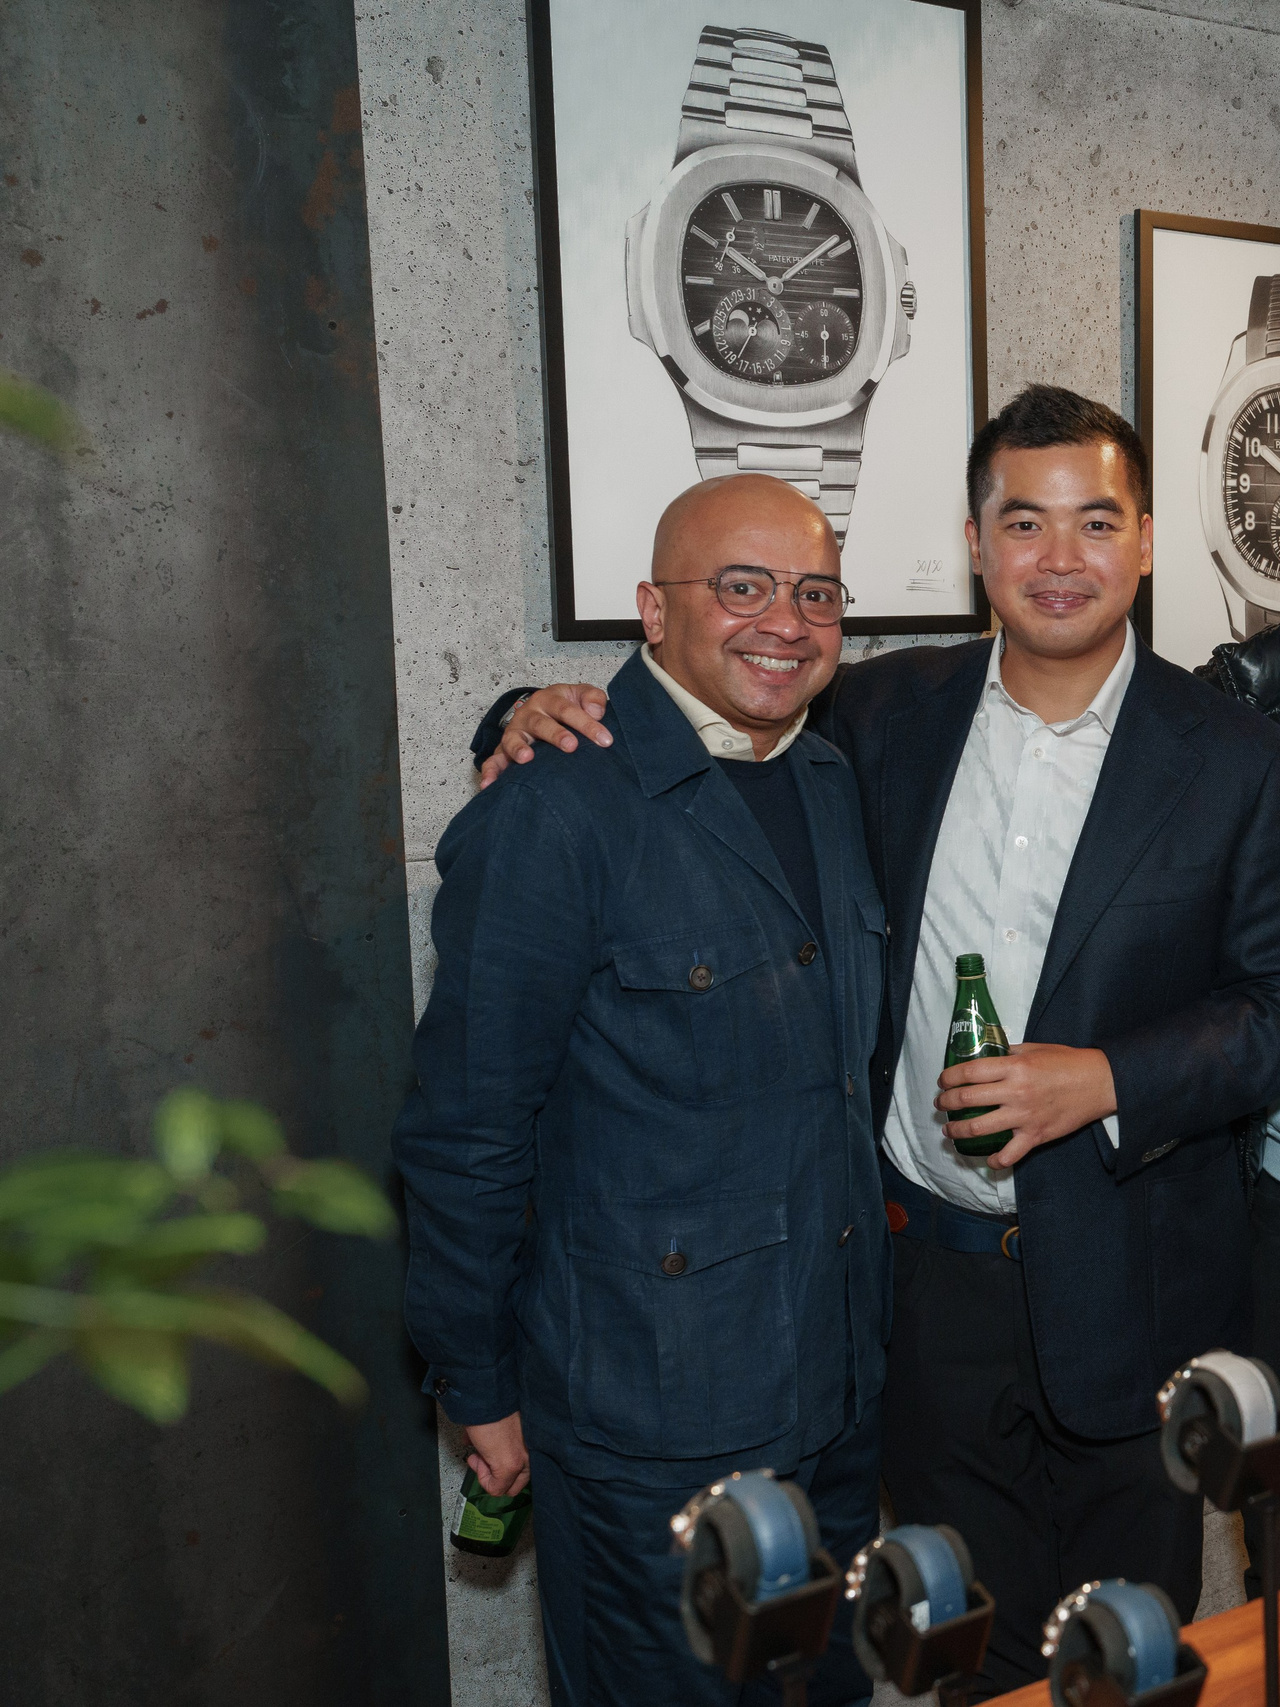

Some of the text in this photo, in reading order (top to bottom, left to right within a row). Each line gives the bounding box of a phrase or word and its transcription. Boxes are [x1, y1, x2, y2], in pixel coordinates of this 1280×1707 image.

[768, 254, 792, 264] PATEK
[1266, 412, 1279, 434] 11
[1245, 437, 1261, 458] 10
[1239, 473, 1251, 494] 9
[1244, 510, 1256, 531] 8
